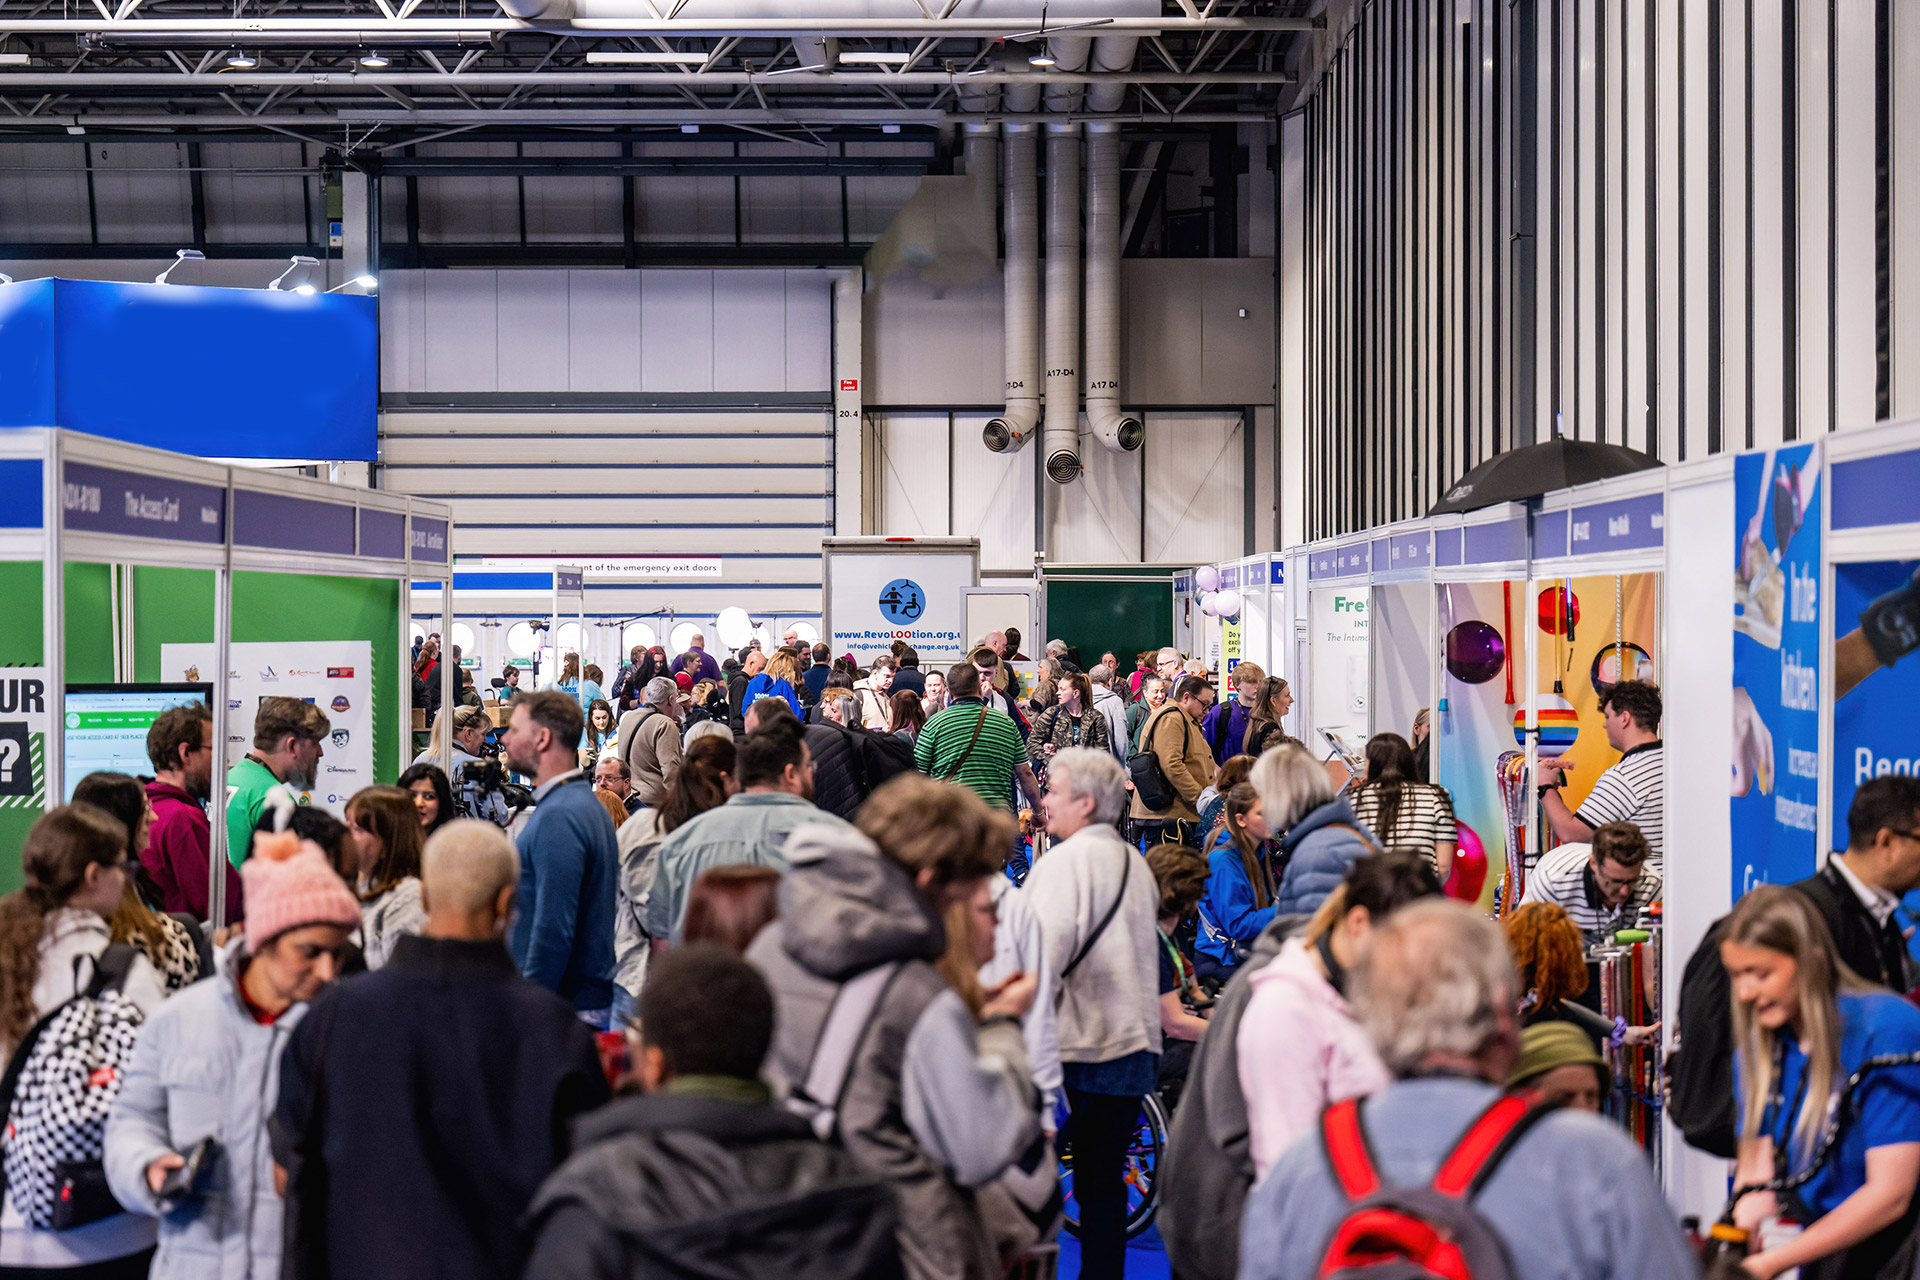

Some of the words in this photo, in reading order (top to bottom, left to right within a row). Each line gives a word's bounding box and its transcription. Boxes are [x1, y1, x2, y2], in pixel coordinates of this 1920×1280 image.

[1047, 369, 1075, 377] A17-D4
[1091, 381, 1107, 389] A17
[839, 410, 858, 418] 20.4
[595, 563, 605, 572] of
[606, 563, 621, 572] the
[623, 564, 671, 574] emergency
[673, 563, 690, 572] exit
[691, 563, 718, 572] doors
[1327, 632, 1342, 642] The
